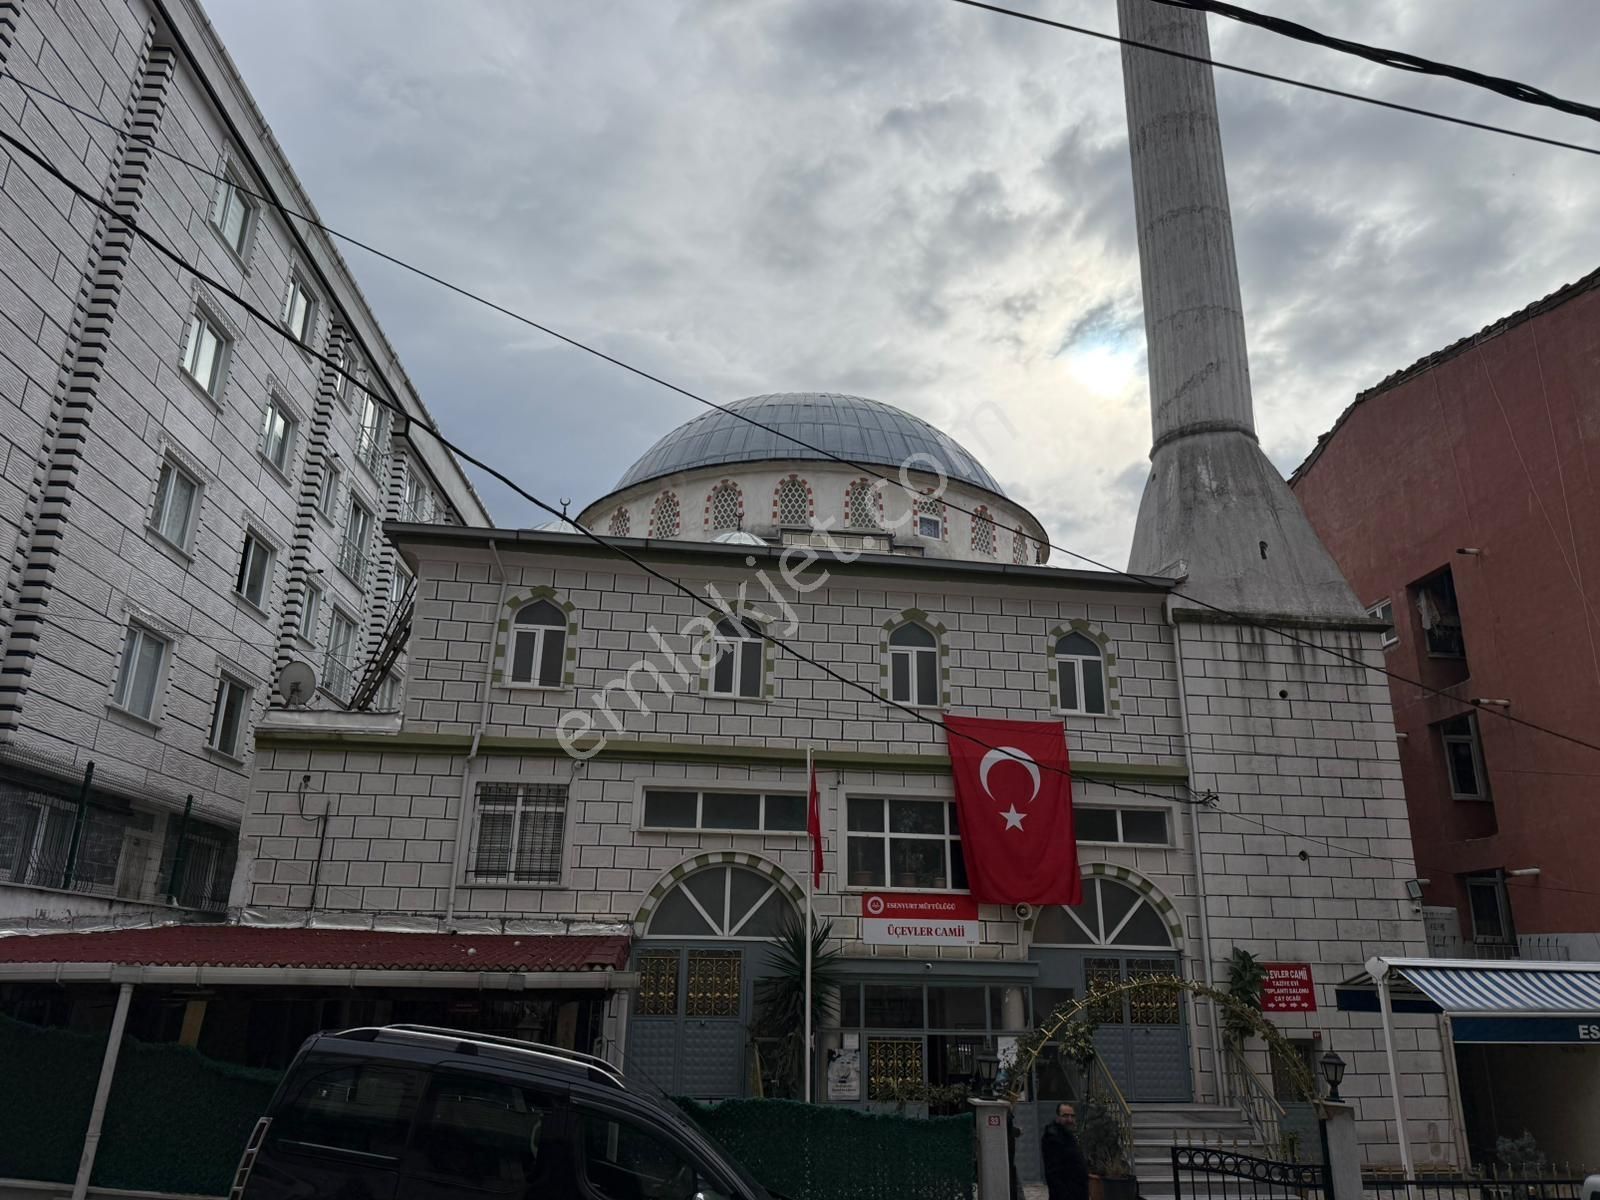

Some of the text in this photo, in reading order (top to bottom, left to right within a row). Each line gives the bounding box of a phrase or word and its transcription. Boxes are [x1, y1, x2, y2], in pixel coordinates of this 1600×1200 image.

[886, 902, 919, 910] ESENYURT
[887, 924, 965, 938] ÜÇEVLER CAMİİ
[1578, 1024, 1600, 1039] ES
